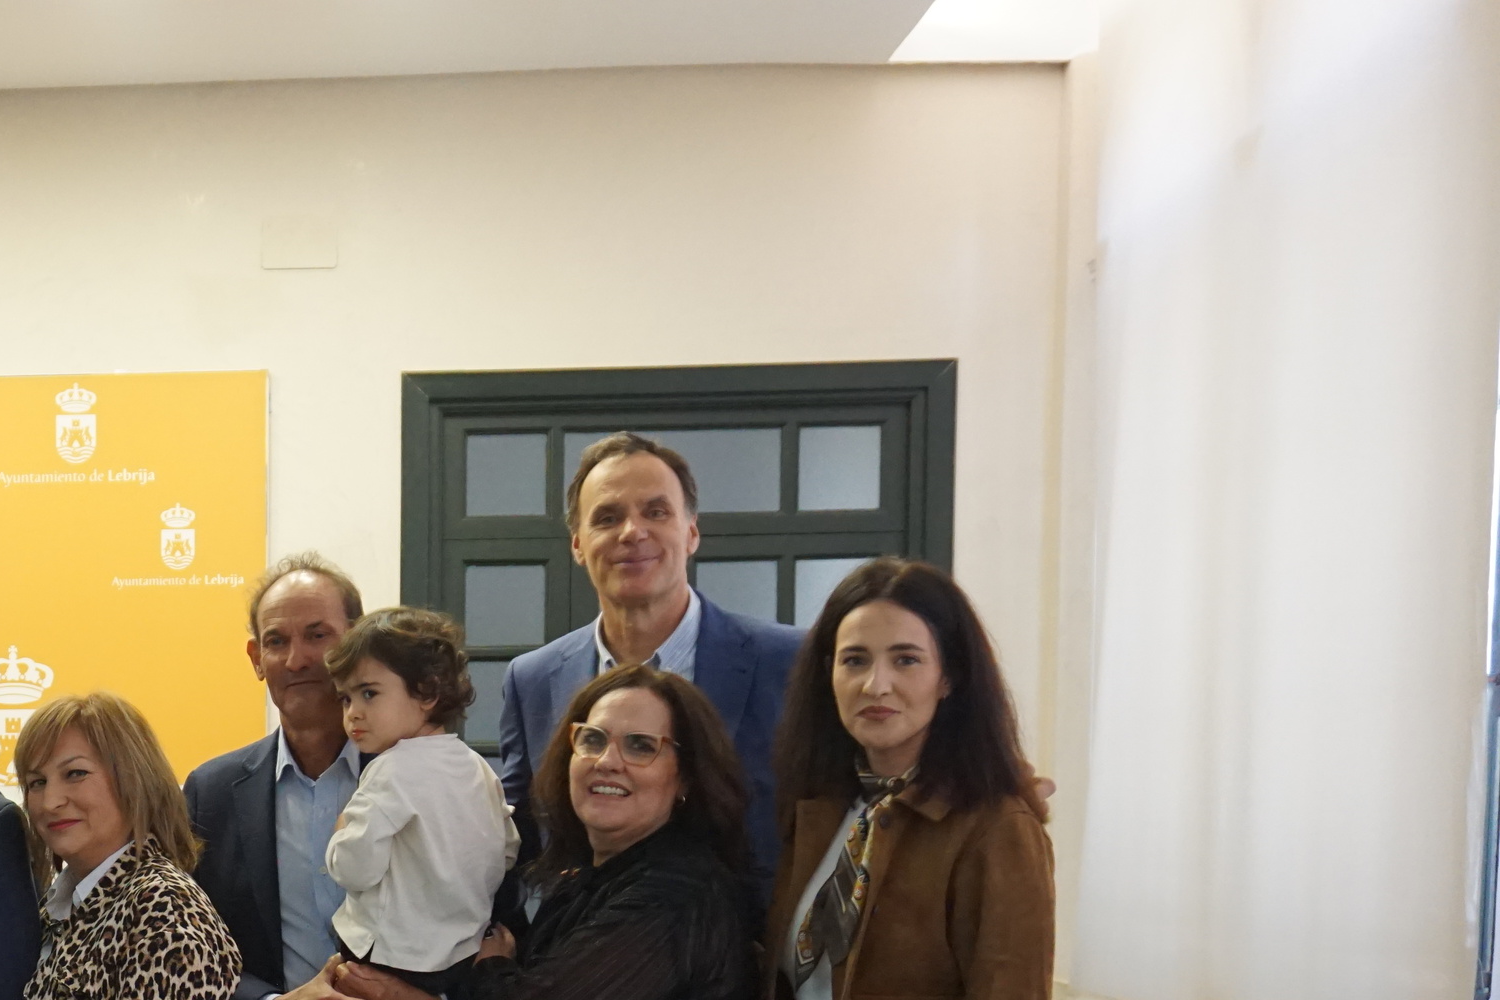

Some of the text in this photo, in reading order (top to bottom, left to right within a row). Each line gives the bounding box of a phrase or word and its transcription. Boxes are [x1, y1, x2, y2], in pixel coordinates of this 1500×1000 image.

[89, 469, 104, 482] de
[108, 468, 156, 485] Lebrija
[112, 572, 244, 589] Ayuntamiento de Lebrija
